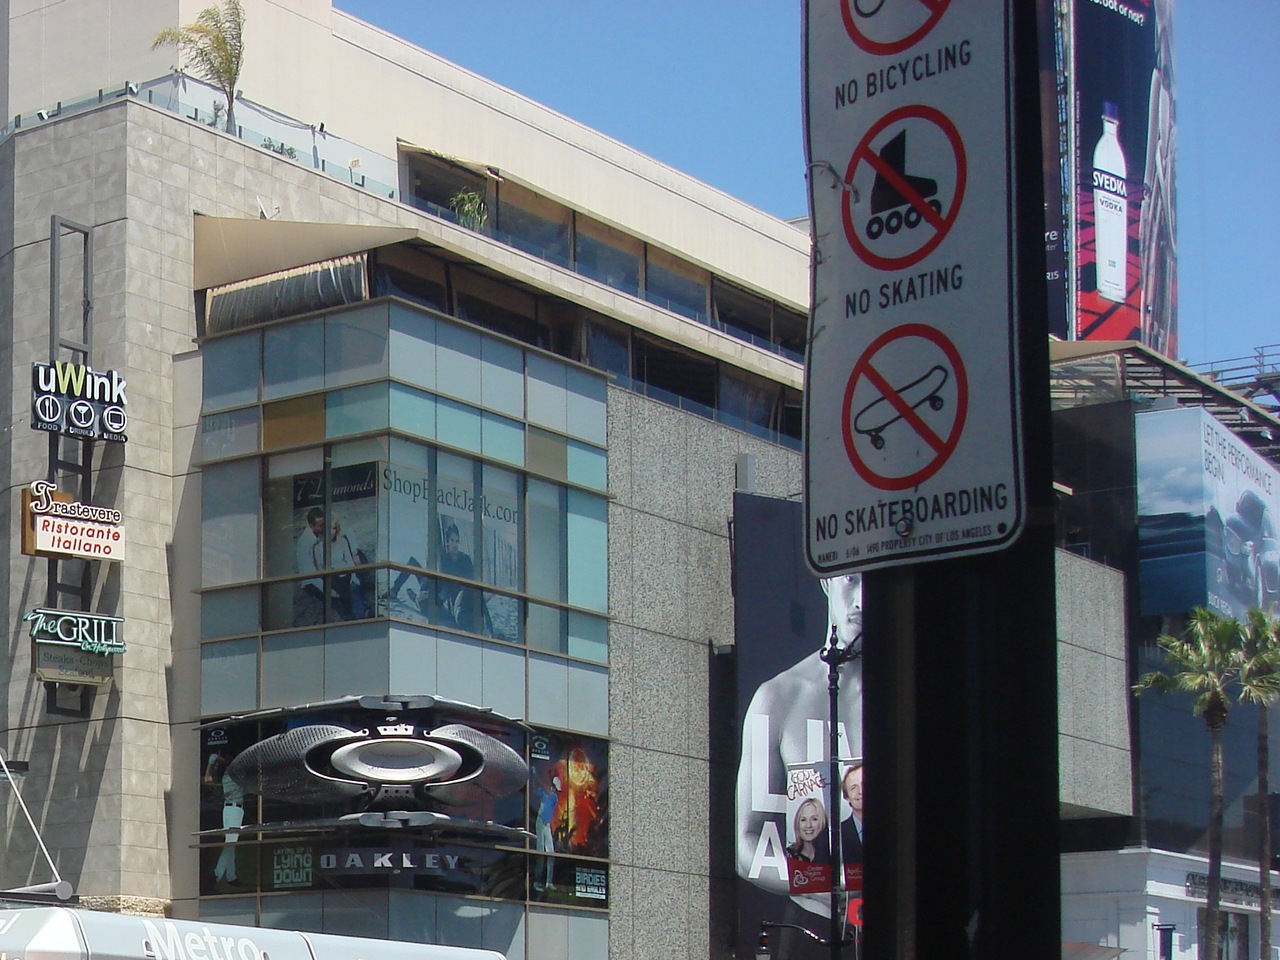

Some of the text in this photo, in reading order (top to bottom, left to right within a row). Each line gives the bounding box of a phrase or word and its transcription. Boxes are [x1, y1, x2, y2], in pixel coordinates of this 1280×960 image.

[835, 40, 971, 109] NO BICYCLING
[1099, 198, 1123, 213] VODKA
[845, 264, 963, 318] NO SKATING
[38, 360, 128, 405] uWink
[37, 422, 58, 431] FOOD
[103, 432, 126, 442] MEDIA
[29, 480, 122, 522] Trastevere
[815, 483, 1008, 542] NO SKATEBOARDING
[41, 519, 121, 542] Ristorante
[880, 536, 917, 551] PROPERTY
[918, 534, 934, 547] CITY
[935, 531, 945, 543] OF
[946, 530, 960, 543] LOS
[961, 524, 993, 540] ANGELES
[51, 535, 112, 555] Italiano
[24, 612, 125, 646] The GRILL
[322, 852, 460, 871] OAKLEY
[576, 872, 606, 886] BIRDIES
